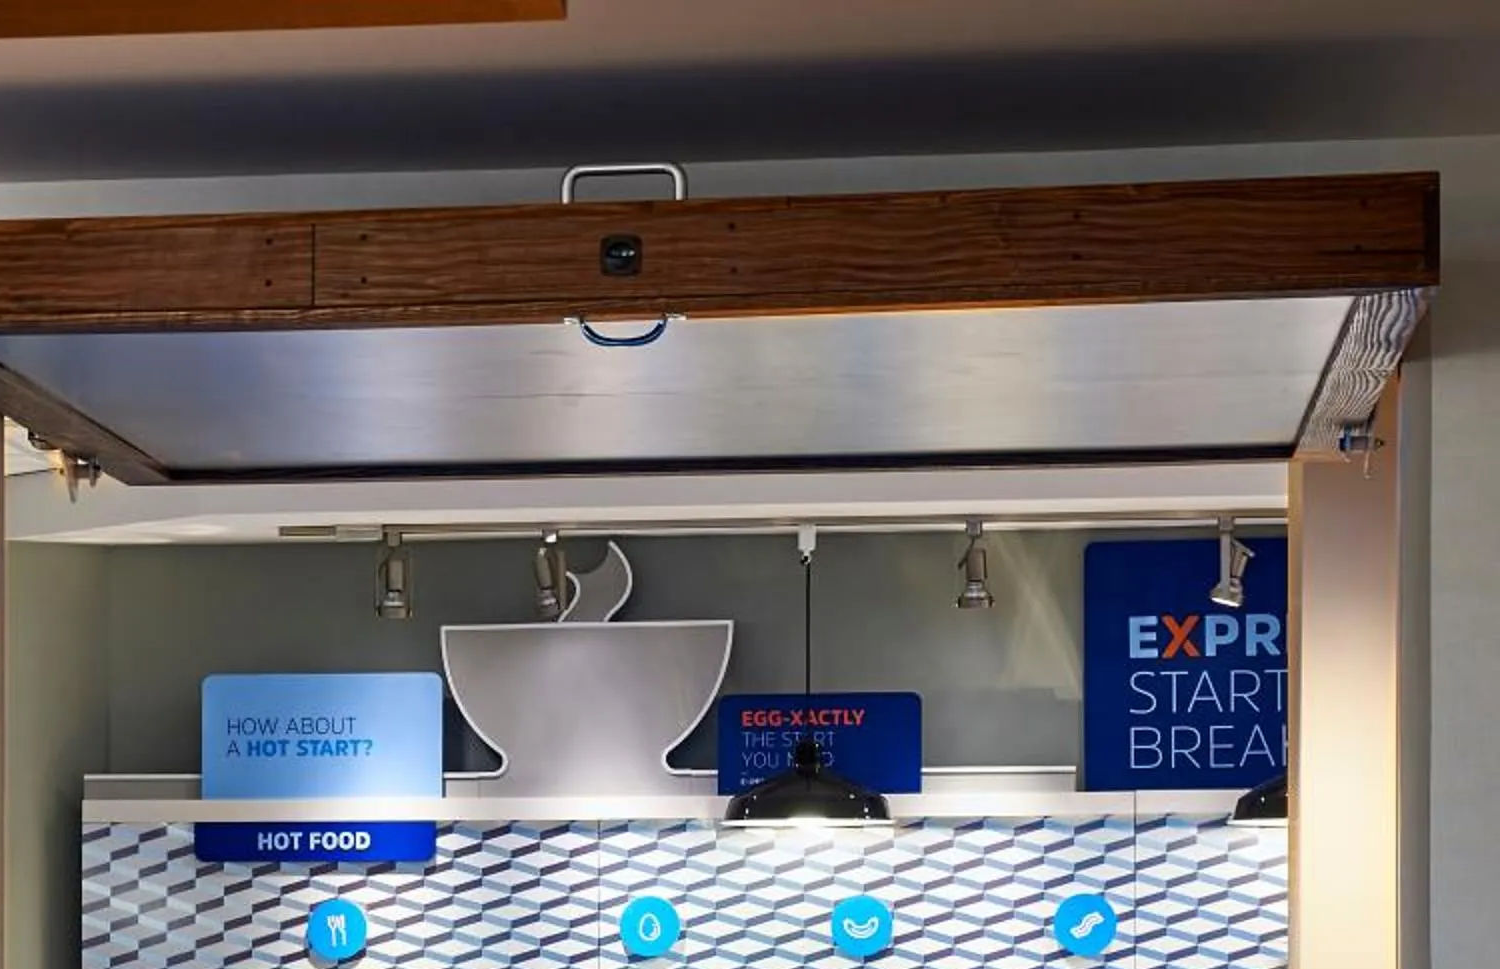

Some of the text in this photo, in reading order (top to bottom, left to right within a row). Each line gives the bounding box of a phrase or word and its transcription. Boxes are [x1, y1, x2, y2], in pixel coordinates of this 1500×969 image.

[1128, 613, 1283, 659] EXPR
[1129, 669, 1288, 715] START
[226, 716, 357, 735] HOW ABOUT
[740, 708, 866, 728] EGG-XACTLY
[226, 739, 374, 757] A HOT START?
[742, 731, 836, 748] THE STRT
[741, 751, 779, 769] YOU
[258, 831, 372, 851] HOT FOOD
